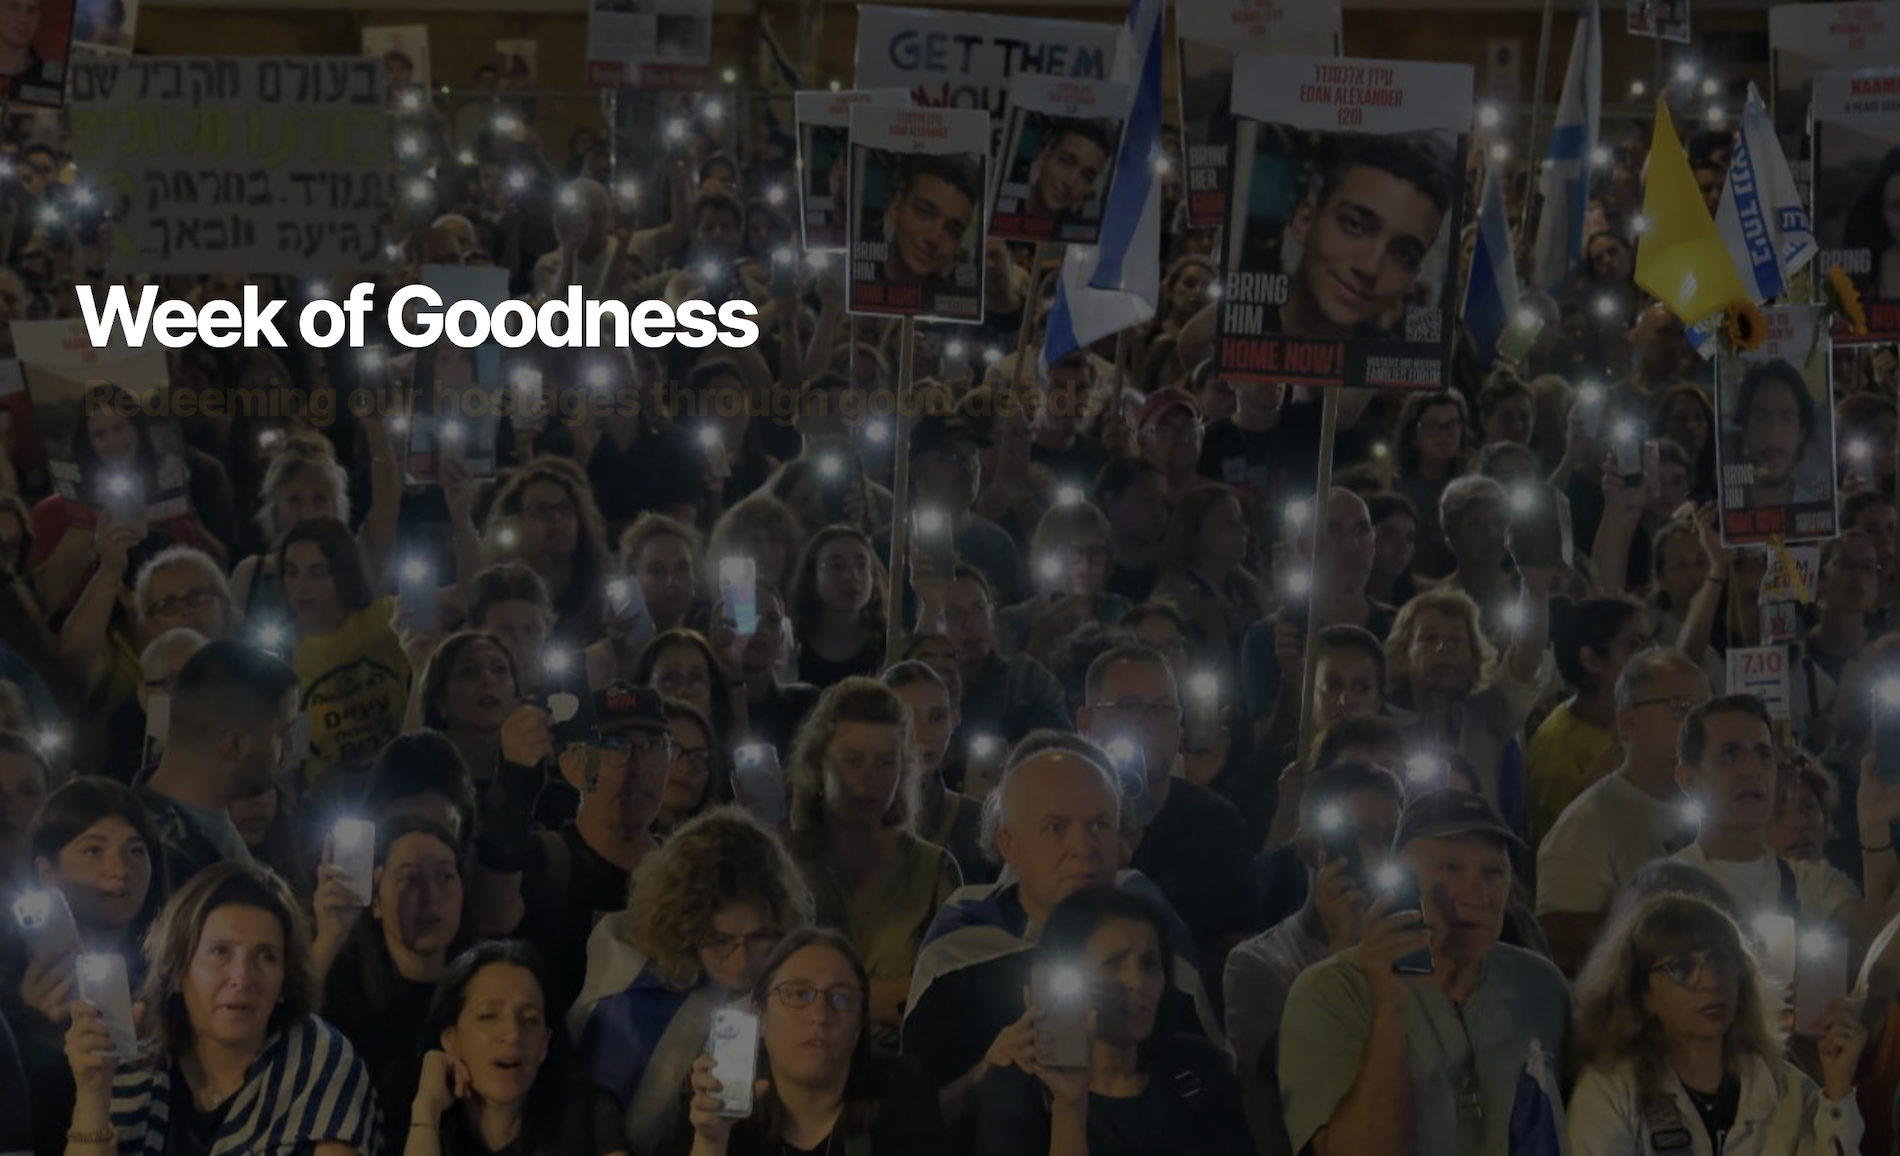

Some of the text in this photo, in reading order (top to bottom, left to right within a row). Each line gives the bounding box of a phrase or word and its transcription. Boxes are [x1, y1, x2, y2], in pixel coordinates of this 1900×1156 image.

[889, 29, 1104, 79] GET THEM
[258, 60, 379, 104] בעולם
[1300, 84, 1404, 108] EDAN ALEXANDER
[1337, 107, 1363, 126] (20)
[1191, 168, 1218, 190] HER
[853, 240, 888, 262] BRING
[1226, 272, 1289, 304] BRING
[1224, 303, 1264, 335] HIM
[1221, 338, 1346, 375] HOME NOW!
[1723, 462, 1755, 486] BRING
[1741, 650, 1783, 677] 7.10
